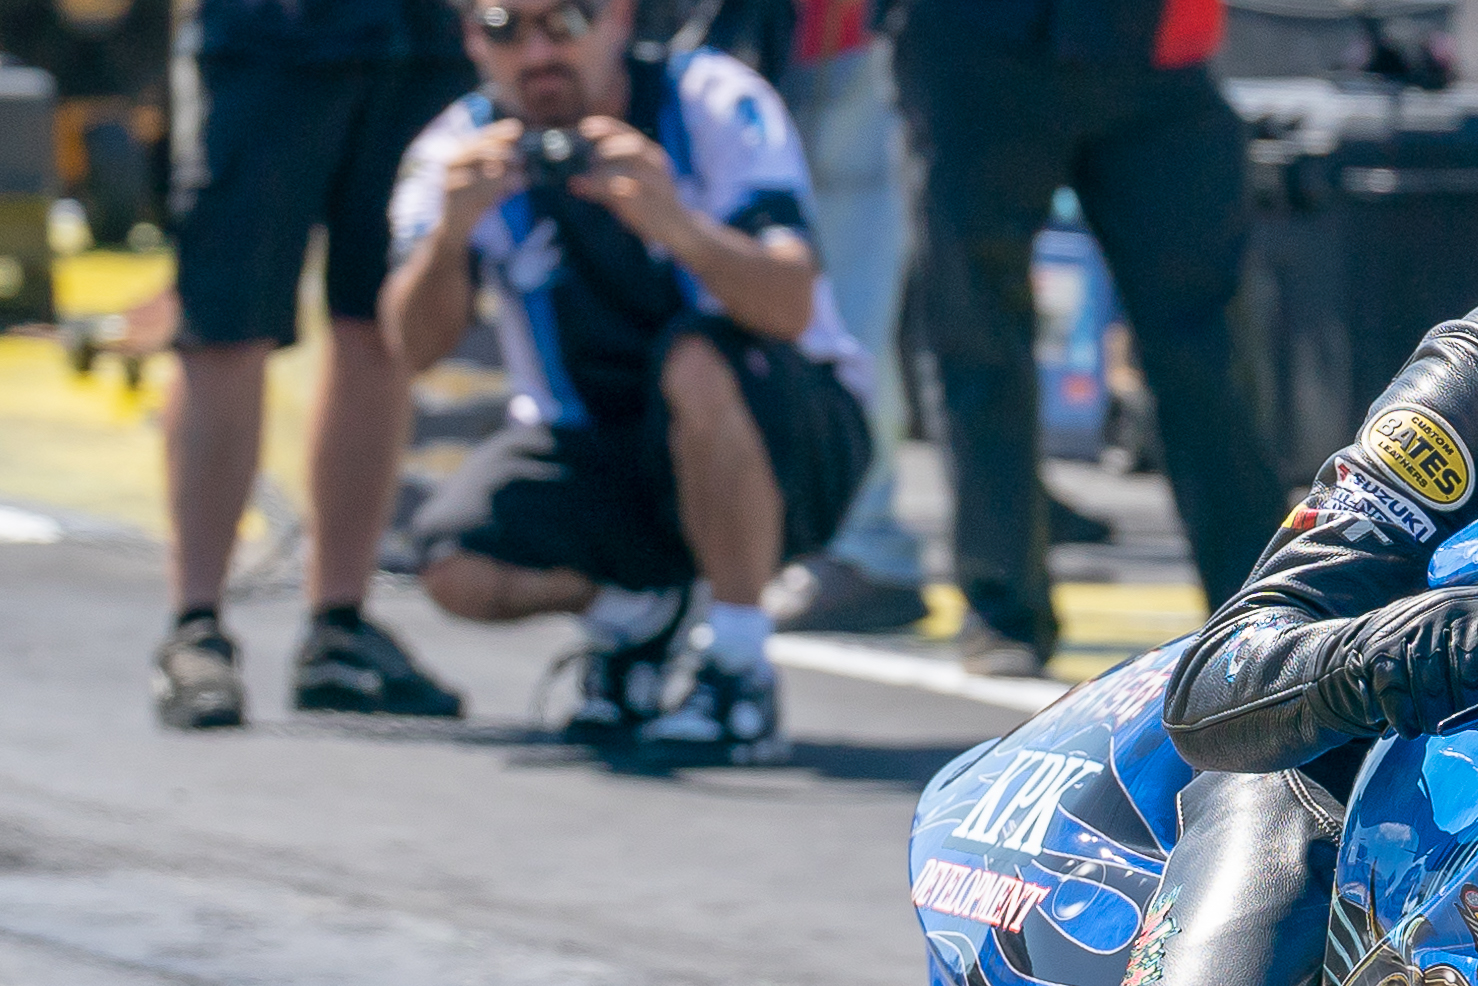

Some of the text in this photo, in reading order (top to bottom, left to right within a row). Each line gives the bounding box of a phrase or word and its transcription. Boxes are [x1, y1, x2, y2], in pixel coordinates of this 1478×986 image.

[1376, 418, 1463, 497] BATES
[1378, 441, 1429, 488] LEATHERS
[1411, 416, 1455, 456] CUSTOM
[1352, 471, 1430, 541] SUZUKI
[951, 750, 1105, 857] KPK
[911, 858, 1052, 934] DEVELOPMENT
